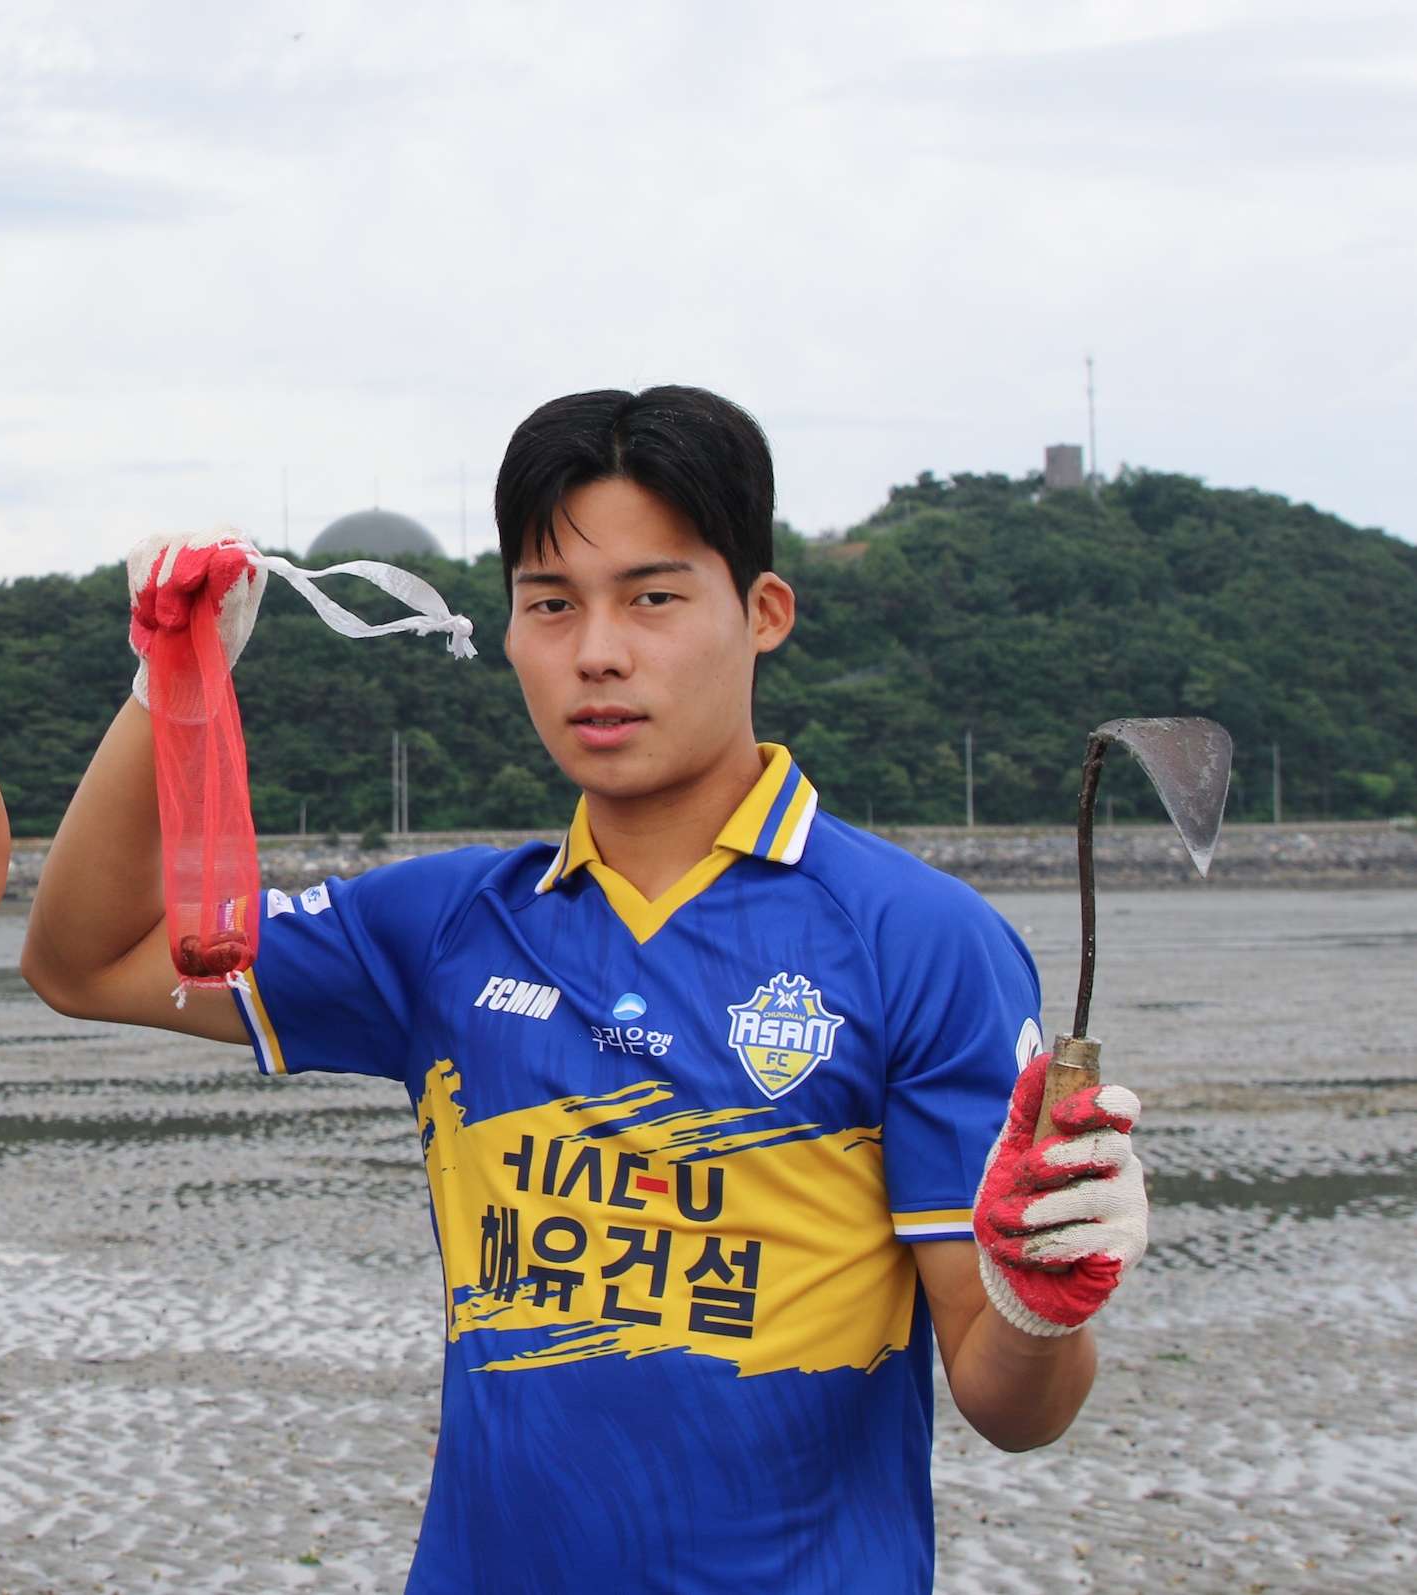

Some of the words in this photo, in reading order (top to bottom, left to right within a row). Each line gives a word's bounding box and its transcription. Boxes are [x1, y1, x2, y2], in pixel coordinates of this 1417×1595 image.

[474, 975, 561, 1021] FCMM
[591, 1026, 674, 1057] 우리은행
[735, 1011, 832, 1055] ASAN
[766, 1051, 789, 1067] FC
[479, 1204, 762, 1339] 해유건설
